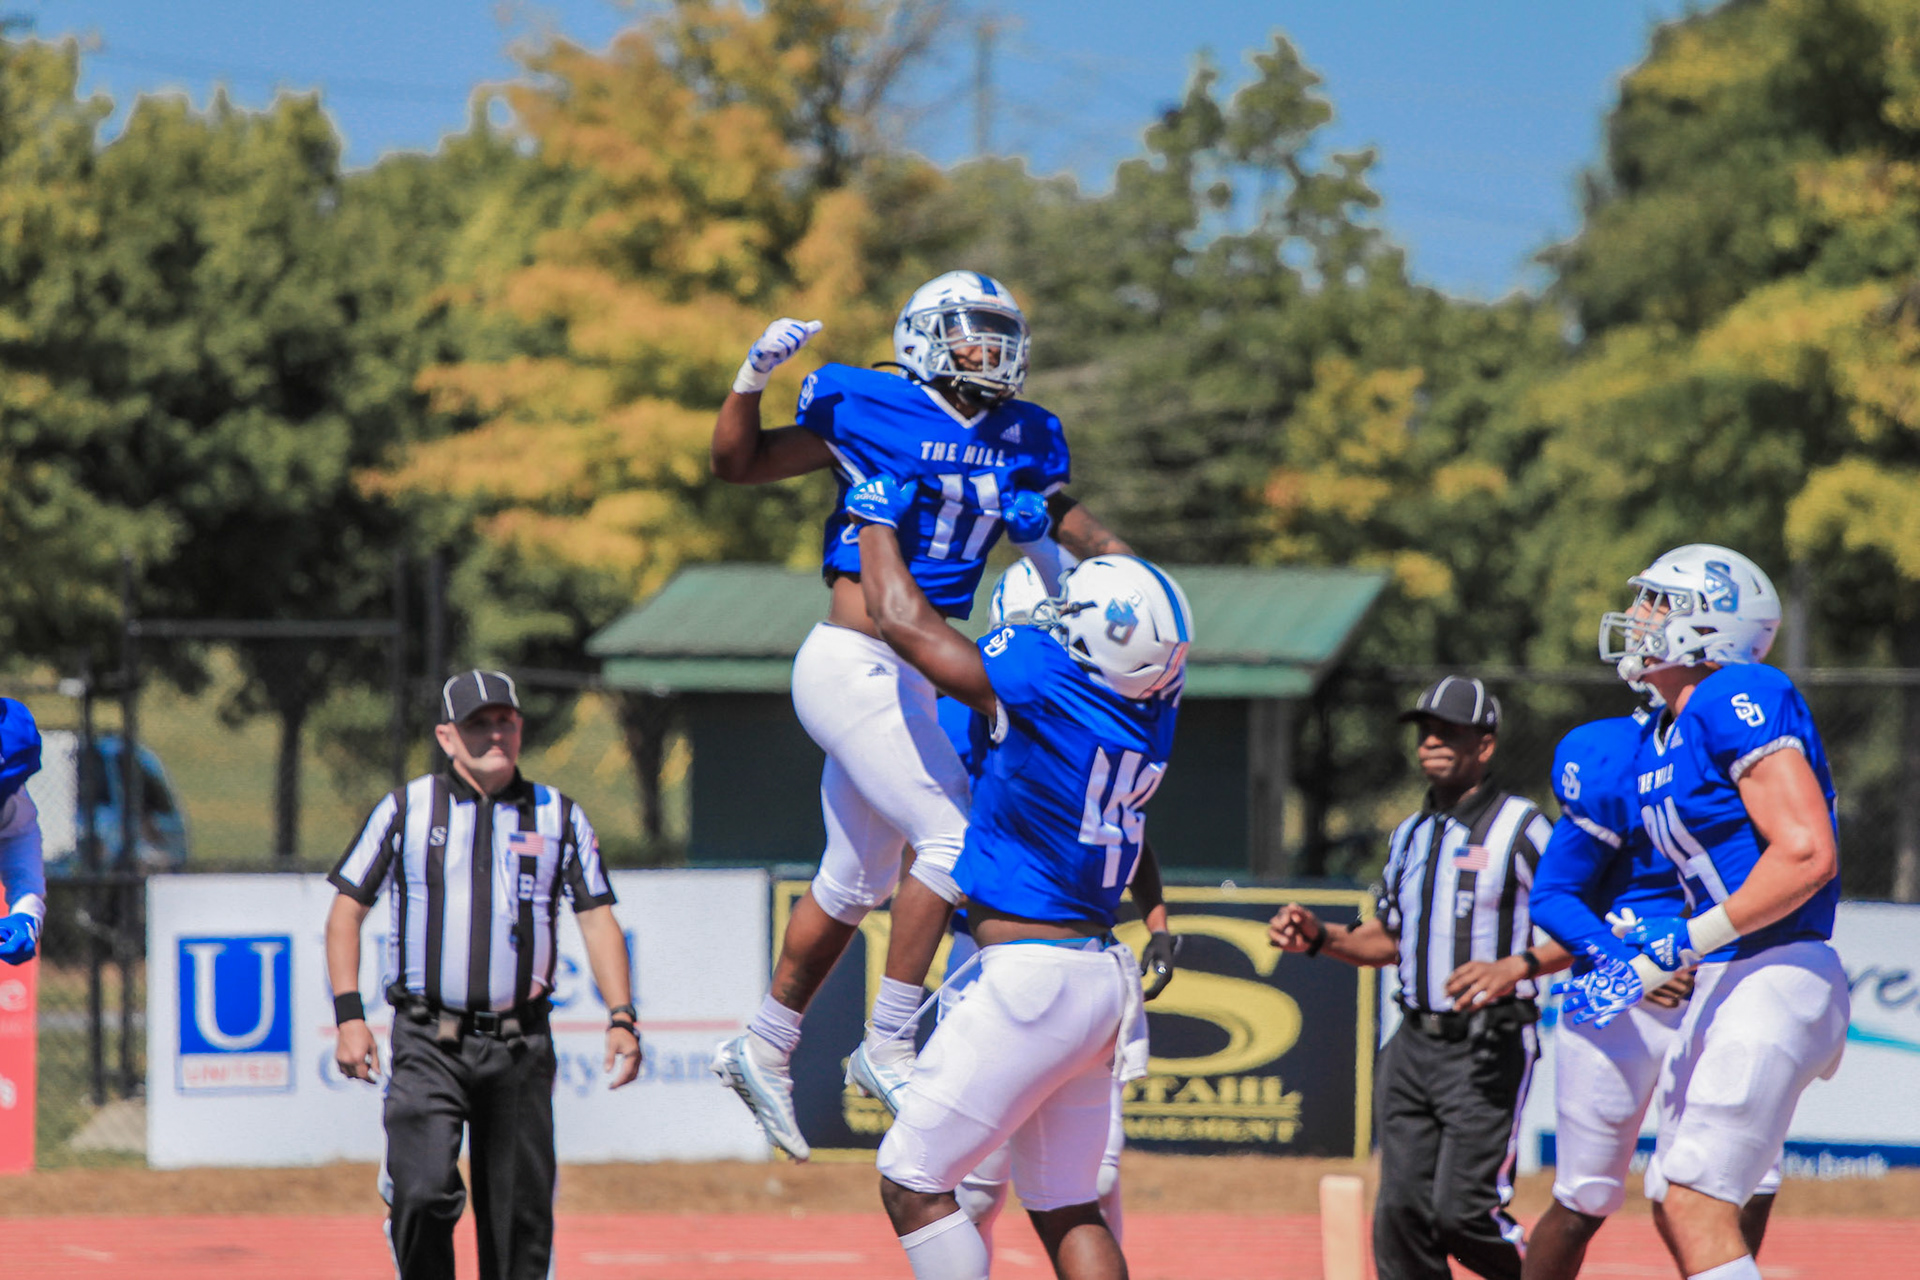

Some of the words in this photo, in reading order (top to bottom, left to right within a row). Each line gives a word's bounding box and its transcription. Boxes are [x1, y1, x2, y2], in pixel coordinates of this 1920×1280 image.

[920, 440, 957, 461] THE
[961, 445, 1006, 467] HILL
[927, 472, 1001, 561] 11
[1731, 692, 1766, 728] SU
[184, 941, 285, 1051] U
